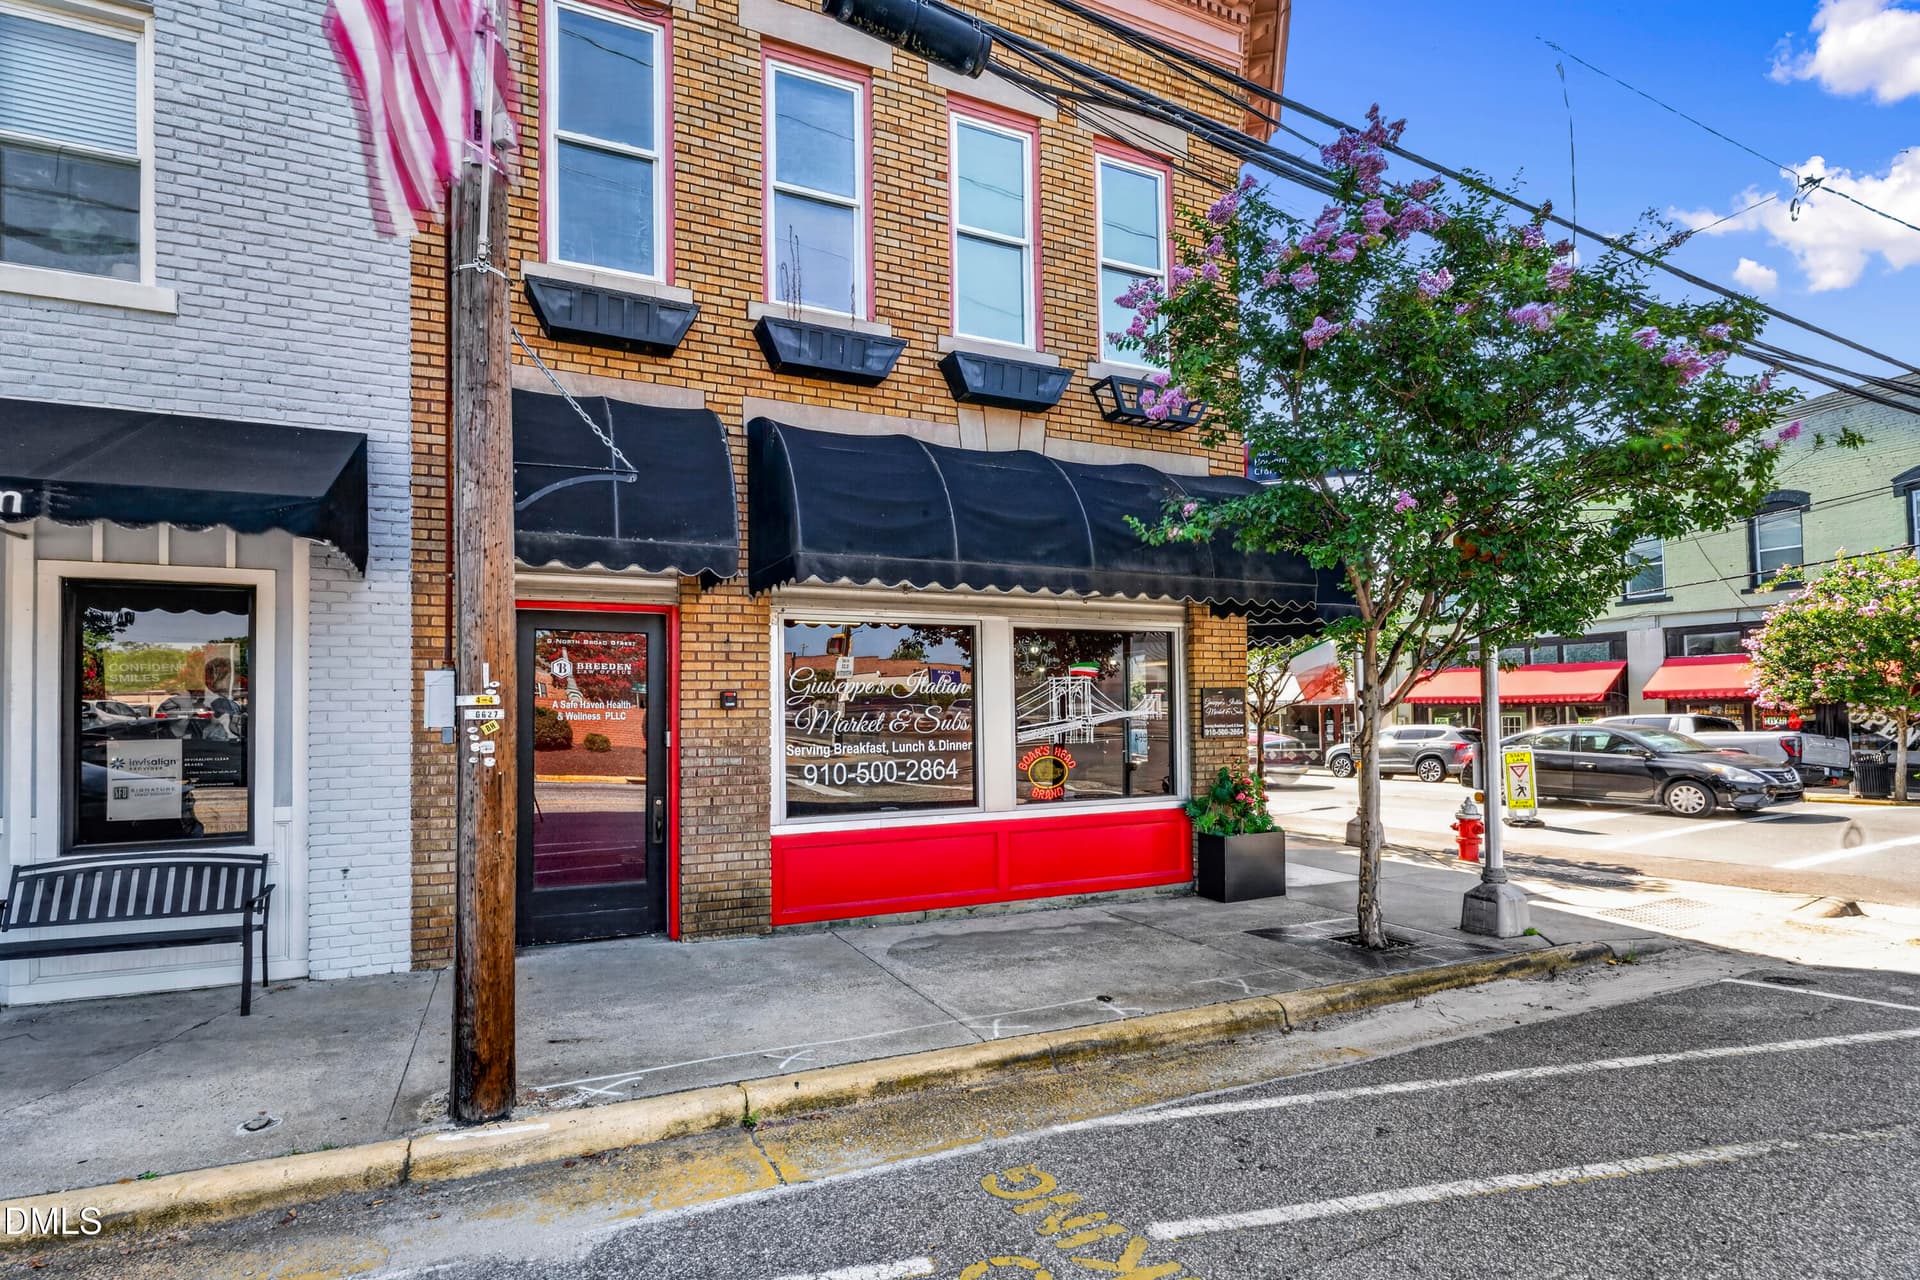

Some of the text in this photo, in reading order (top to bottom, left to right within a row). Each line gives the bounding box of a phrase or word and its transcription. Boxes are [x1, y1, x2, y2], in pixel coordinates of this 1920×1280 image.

[576, 662, 632, 670] BREEDEN
[109, 673, 160, 682] SMILES
[786, 667, 888, 706] Giuseppe's
[891, 667, 972, 699] Italian
[552, 700, 631, 709] A Safe Haven Health
[557, 711, 627, 721] & Wellness PLLC
[794, 705, 971, 736] Market & Subs
[786, 739, 973, 758] Serving Breakfast, Lunch & Dinner
[129, 756, 177, 767] invisalign
[1017, 745, 1077, 771] BOAR'S HEAD
[803, 758, 959, 786] 910-500-2864
[1031, 786, 1064, 800] BRAND
